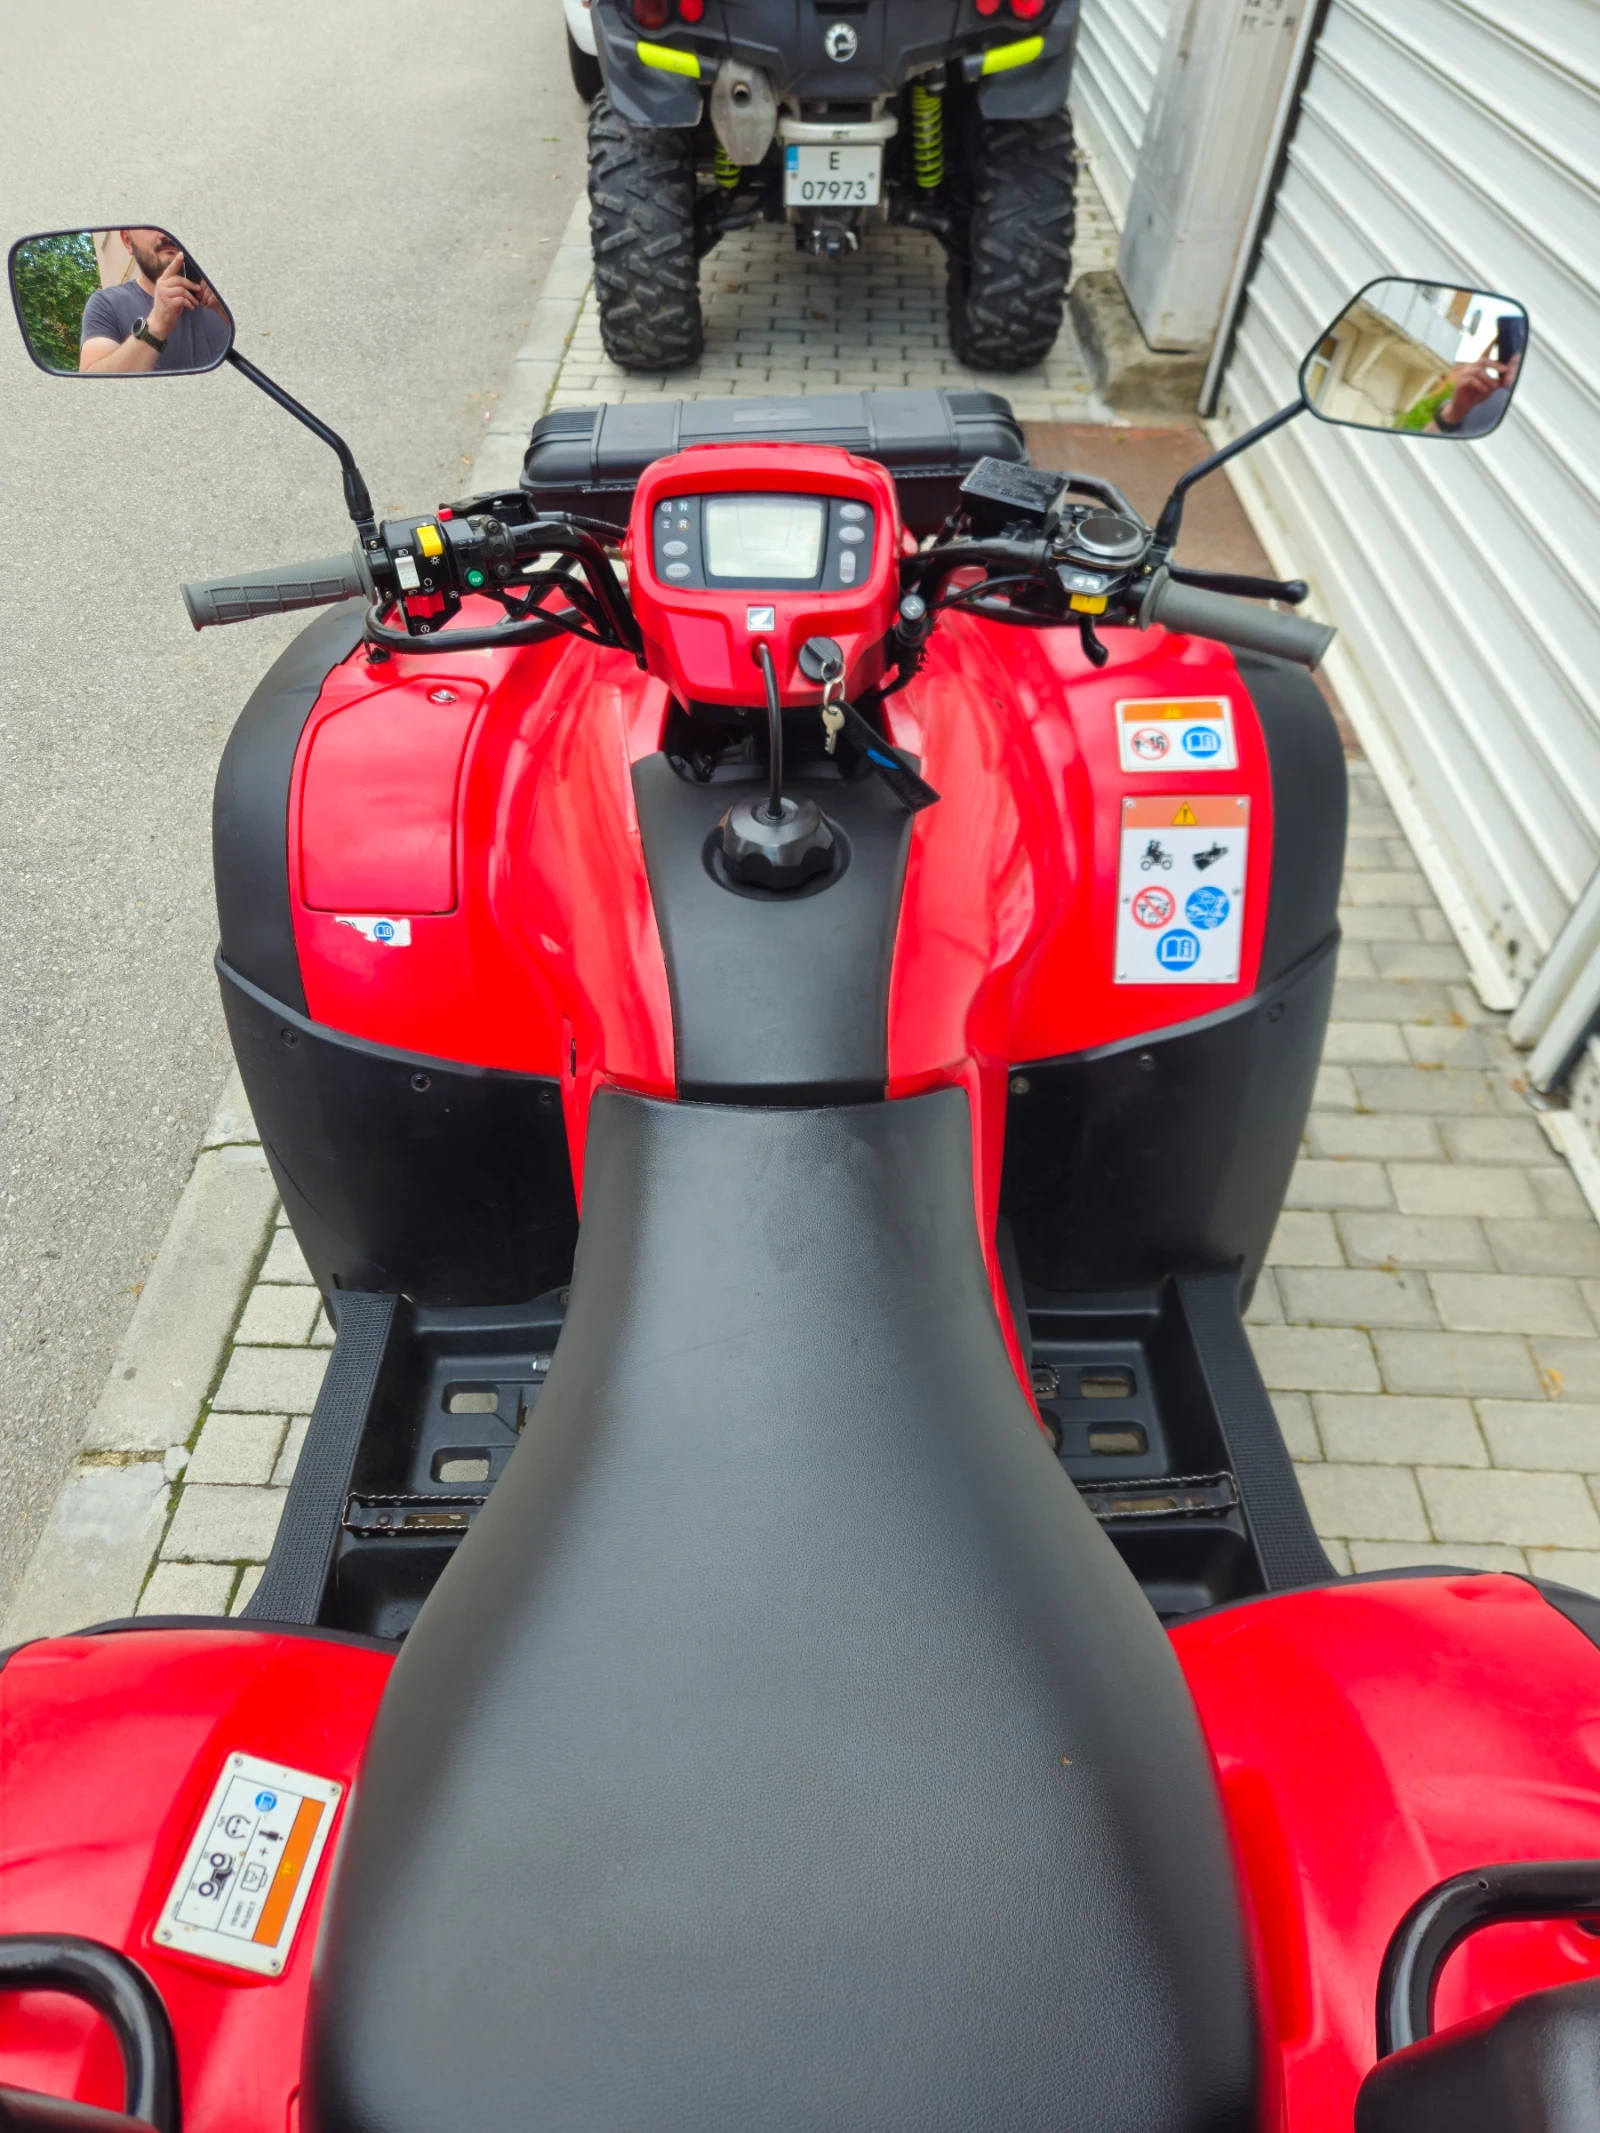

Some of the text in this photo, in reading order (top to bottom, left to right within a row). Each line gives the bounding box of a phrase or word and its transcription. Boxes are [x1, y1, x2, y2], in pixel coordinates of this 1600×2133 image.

[829, 151, 841, 171] E
[802, 181, 867, 200] 07973
[680, 502, 688, 512] N
[680, 520, 687, 529] R
